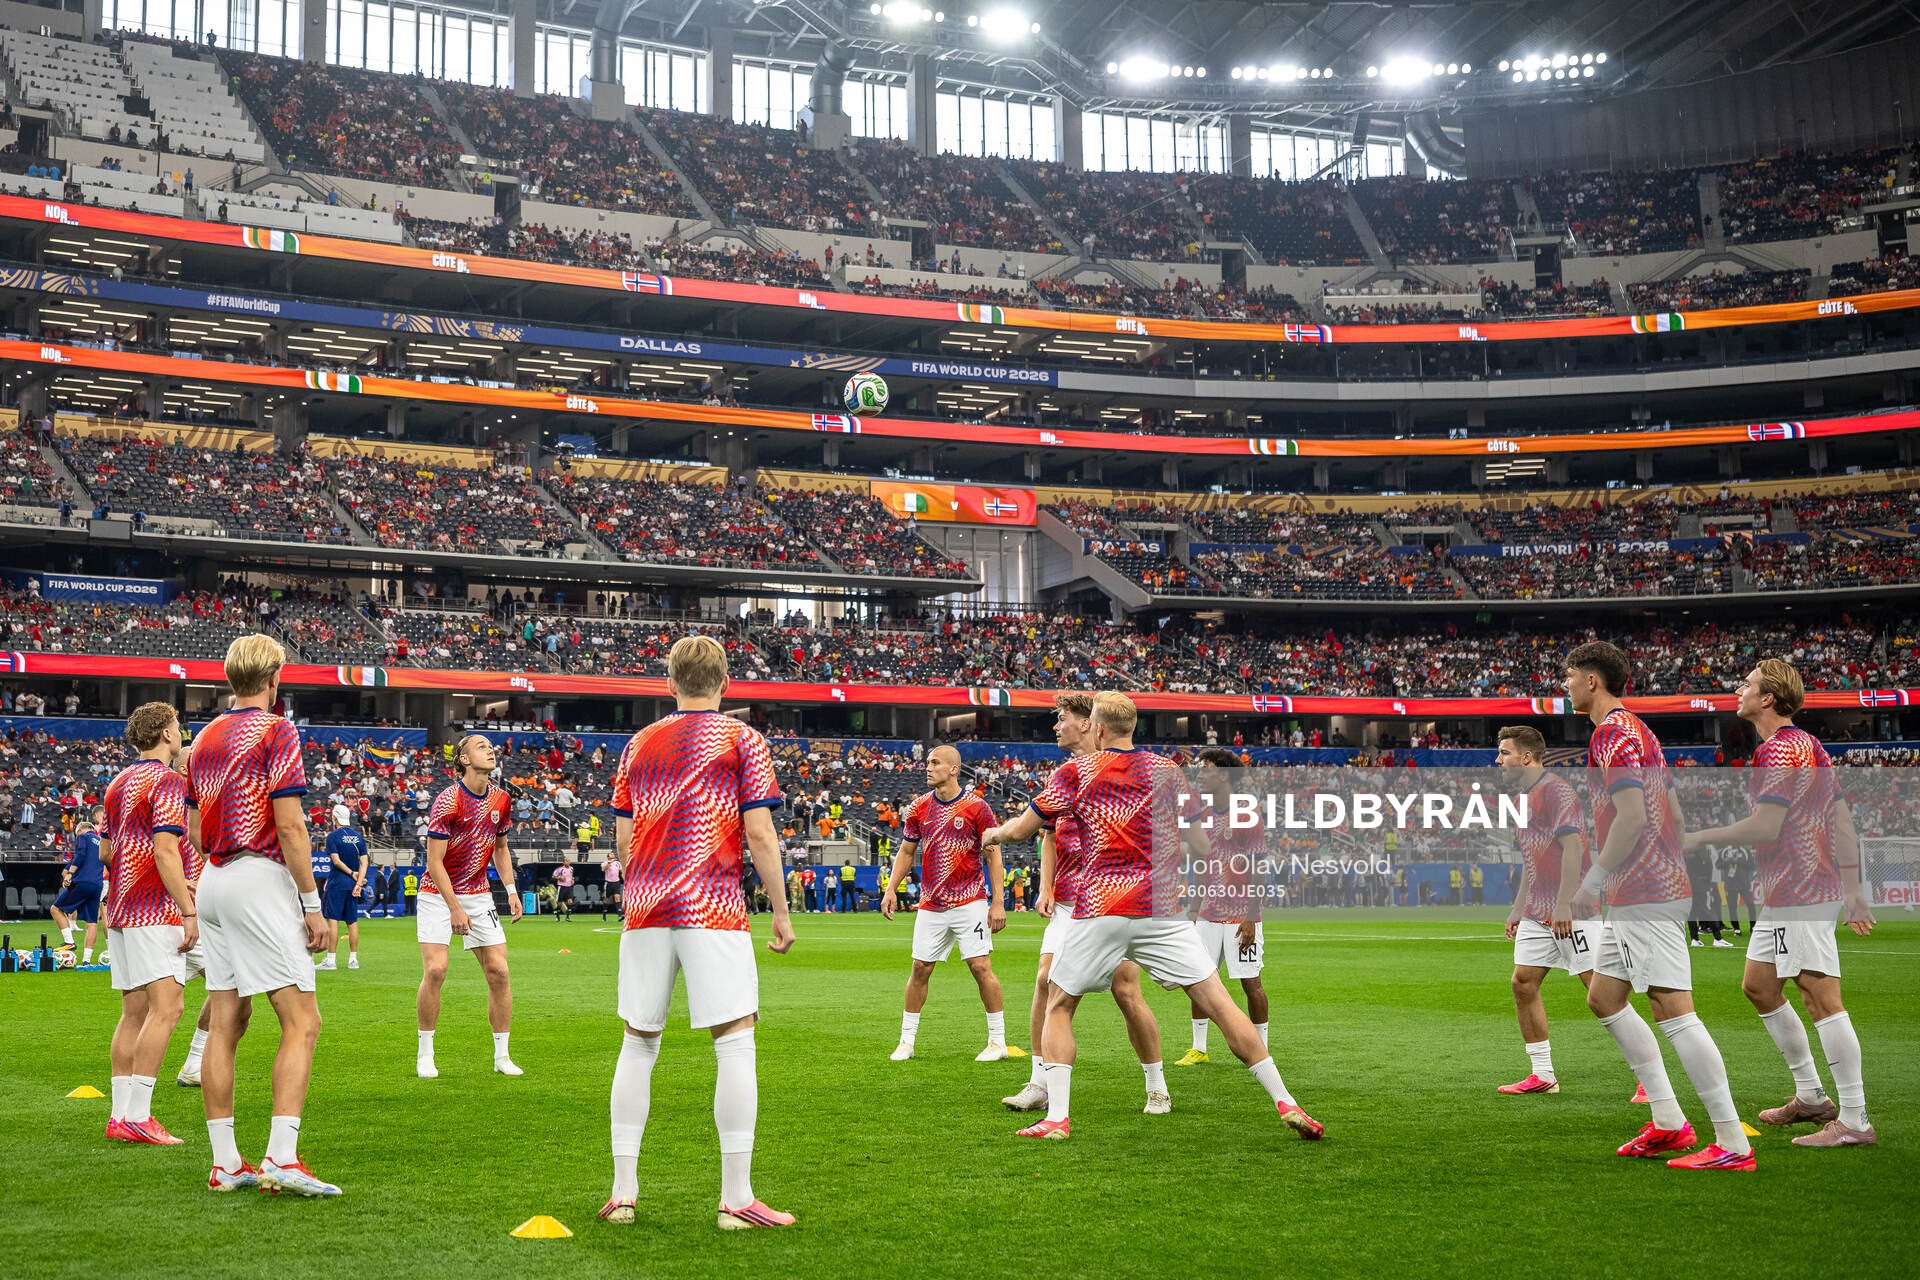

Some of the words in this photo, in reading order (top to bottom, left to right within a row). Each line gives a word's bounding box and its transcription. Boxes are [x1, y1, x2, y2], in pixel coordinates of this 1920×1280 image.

[207, 294, 281, 314] #FIFAWorldCup
[1818, 299, 1842, 314] CÔTE
[620, 337, 702, 354] DALLAS
[912, 362, 937, 374] FIFA
[939, 364, 982, 377] WORLD
[984, 367, 1007, 379] CUP
[1009, 369, 1049, 382] 2026
[1502, 545, 1531, 557] FIFA
[1534, 543, 1587, 556] WORL
[1618, 541, 1669, 553] 2026
[49, 580, 70, 590] FIFA
[70, 581, 104, 592] WORLD
[105, 584, 124, 593] CUP
[125, 585, 158, 595] 2026
[973, 921, 984, 941] 4
[1568, 929, 1590, 954] 15
[1773, 927, 1788, 956] 18
